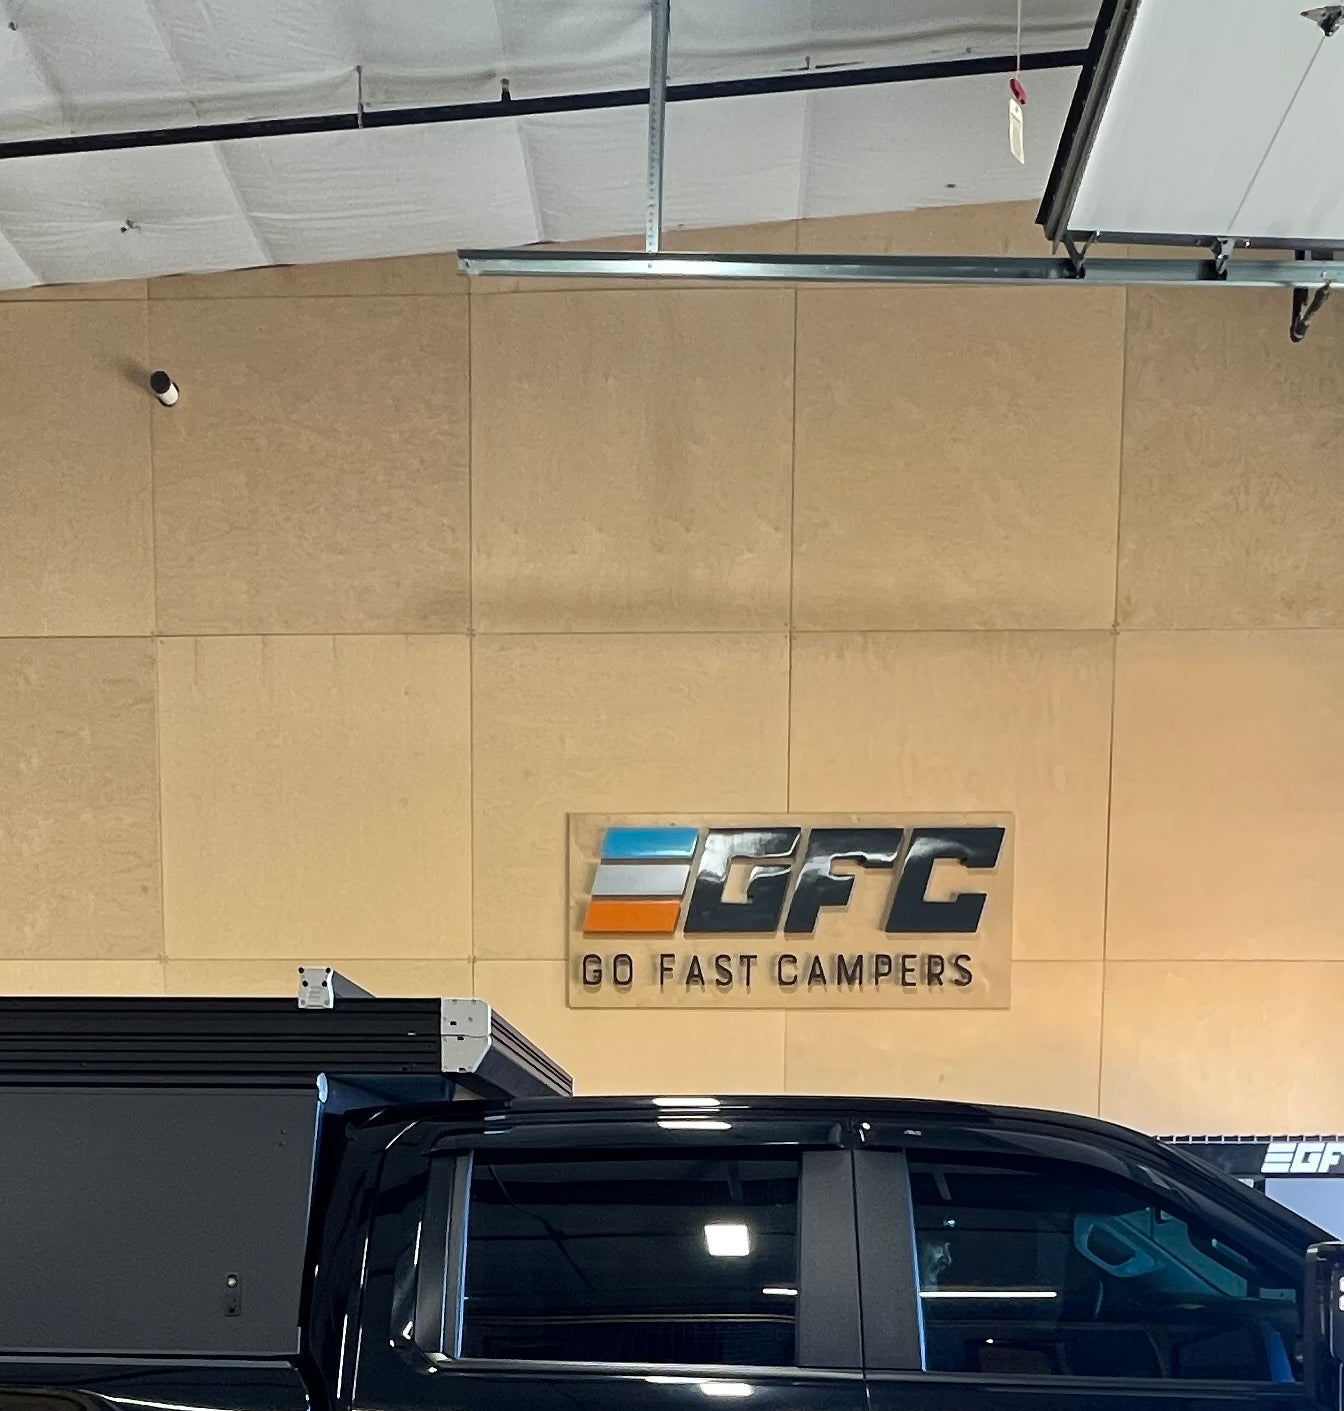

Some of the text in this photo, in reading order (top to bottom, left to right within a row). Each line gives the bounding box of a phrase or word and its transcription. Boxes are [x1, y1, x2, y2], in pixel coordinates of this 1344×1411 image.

[581, 952, 975, 987] GO FAST CAMPERS
